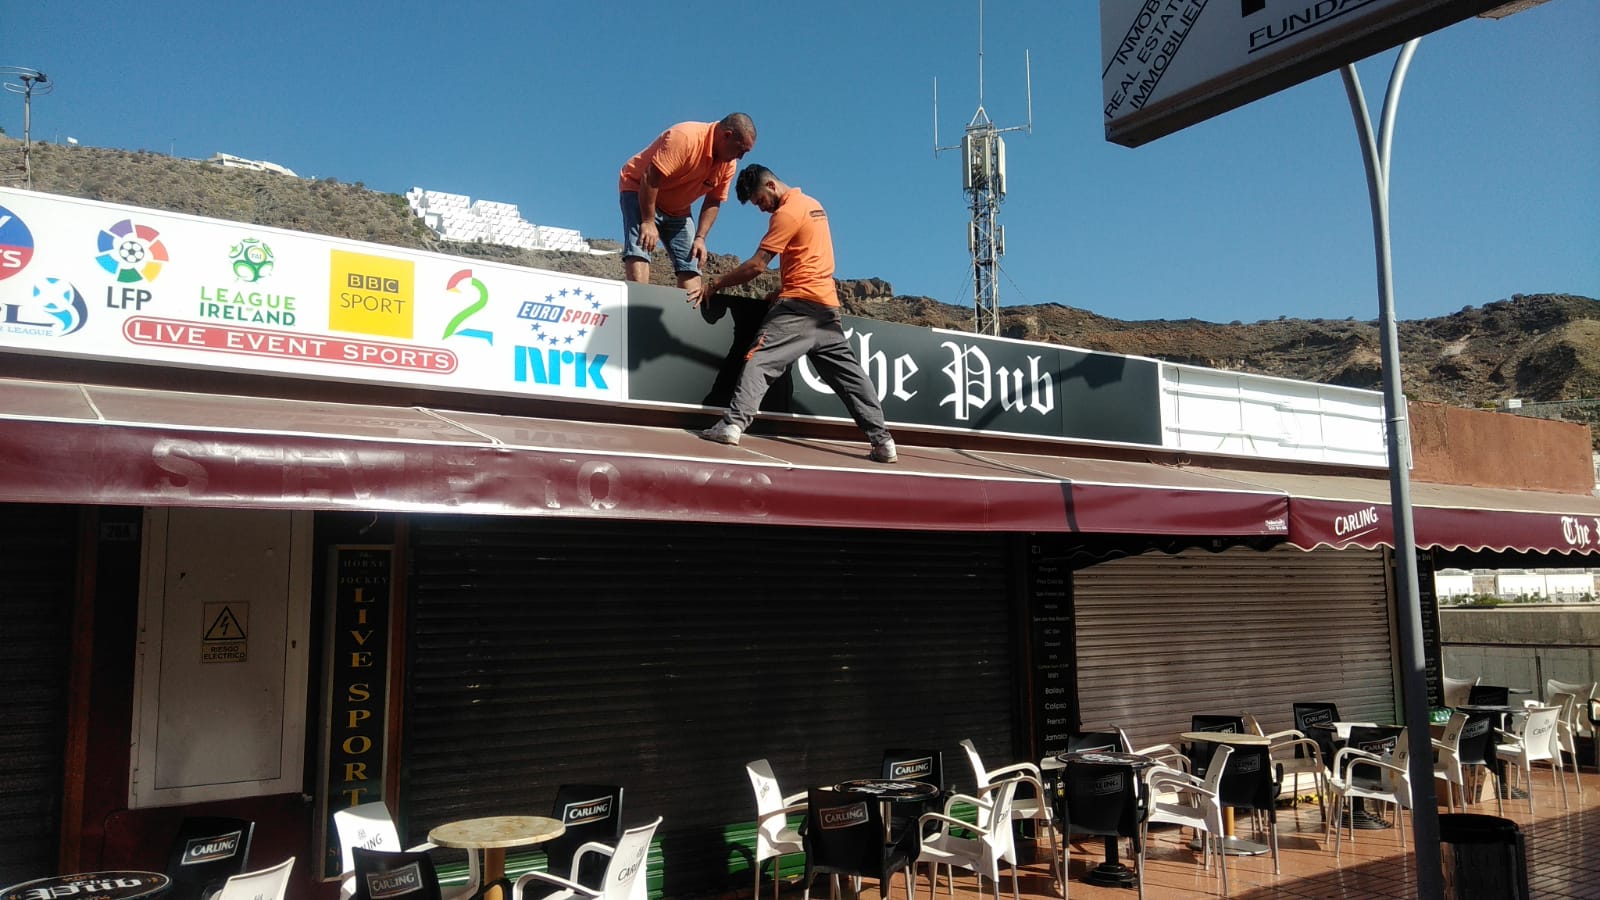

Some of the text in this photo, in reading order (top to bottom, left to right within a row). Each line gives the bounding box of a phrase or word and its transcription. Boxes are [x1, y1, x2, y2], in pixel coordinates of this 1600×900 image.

[1103, 0, 1183, 118] REAL ESTAT
[0, 249, 21, 268] S
[349, 274, 398, 293] BBC
[106, 285, 152, 311] LFP
[200, 285, 296, 310] LEAGUE
[340, 292, 406, 314] SPORT
[199, 302, 296, 326] IRELAND
[7, 326, 54, 337] LEAGUE
[134, 321, 449, 369] LIVE EVENT SPORTS
[939, 341, 1055, 420] Pub
[1335, 506, 1378, 536] CARLING
[1561, 516, 1591, 549] The
[351, 588, 375, 668] LIVE
[895, 762, 929, 775] CARLING
[569, 803, 609, 819] CARLING
[824, 808, 864, 823] CARLING
[190, 839, 236, 857] CARLING
[372, 872, 415, 892] CARLING
